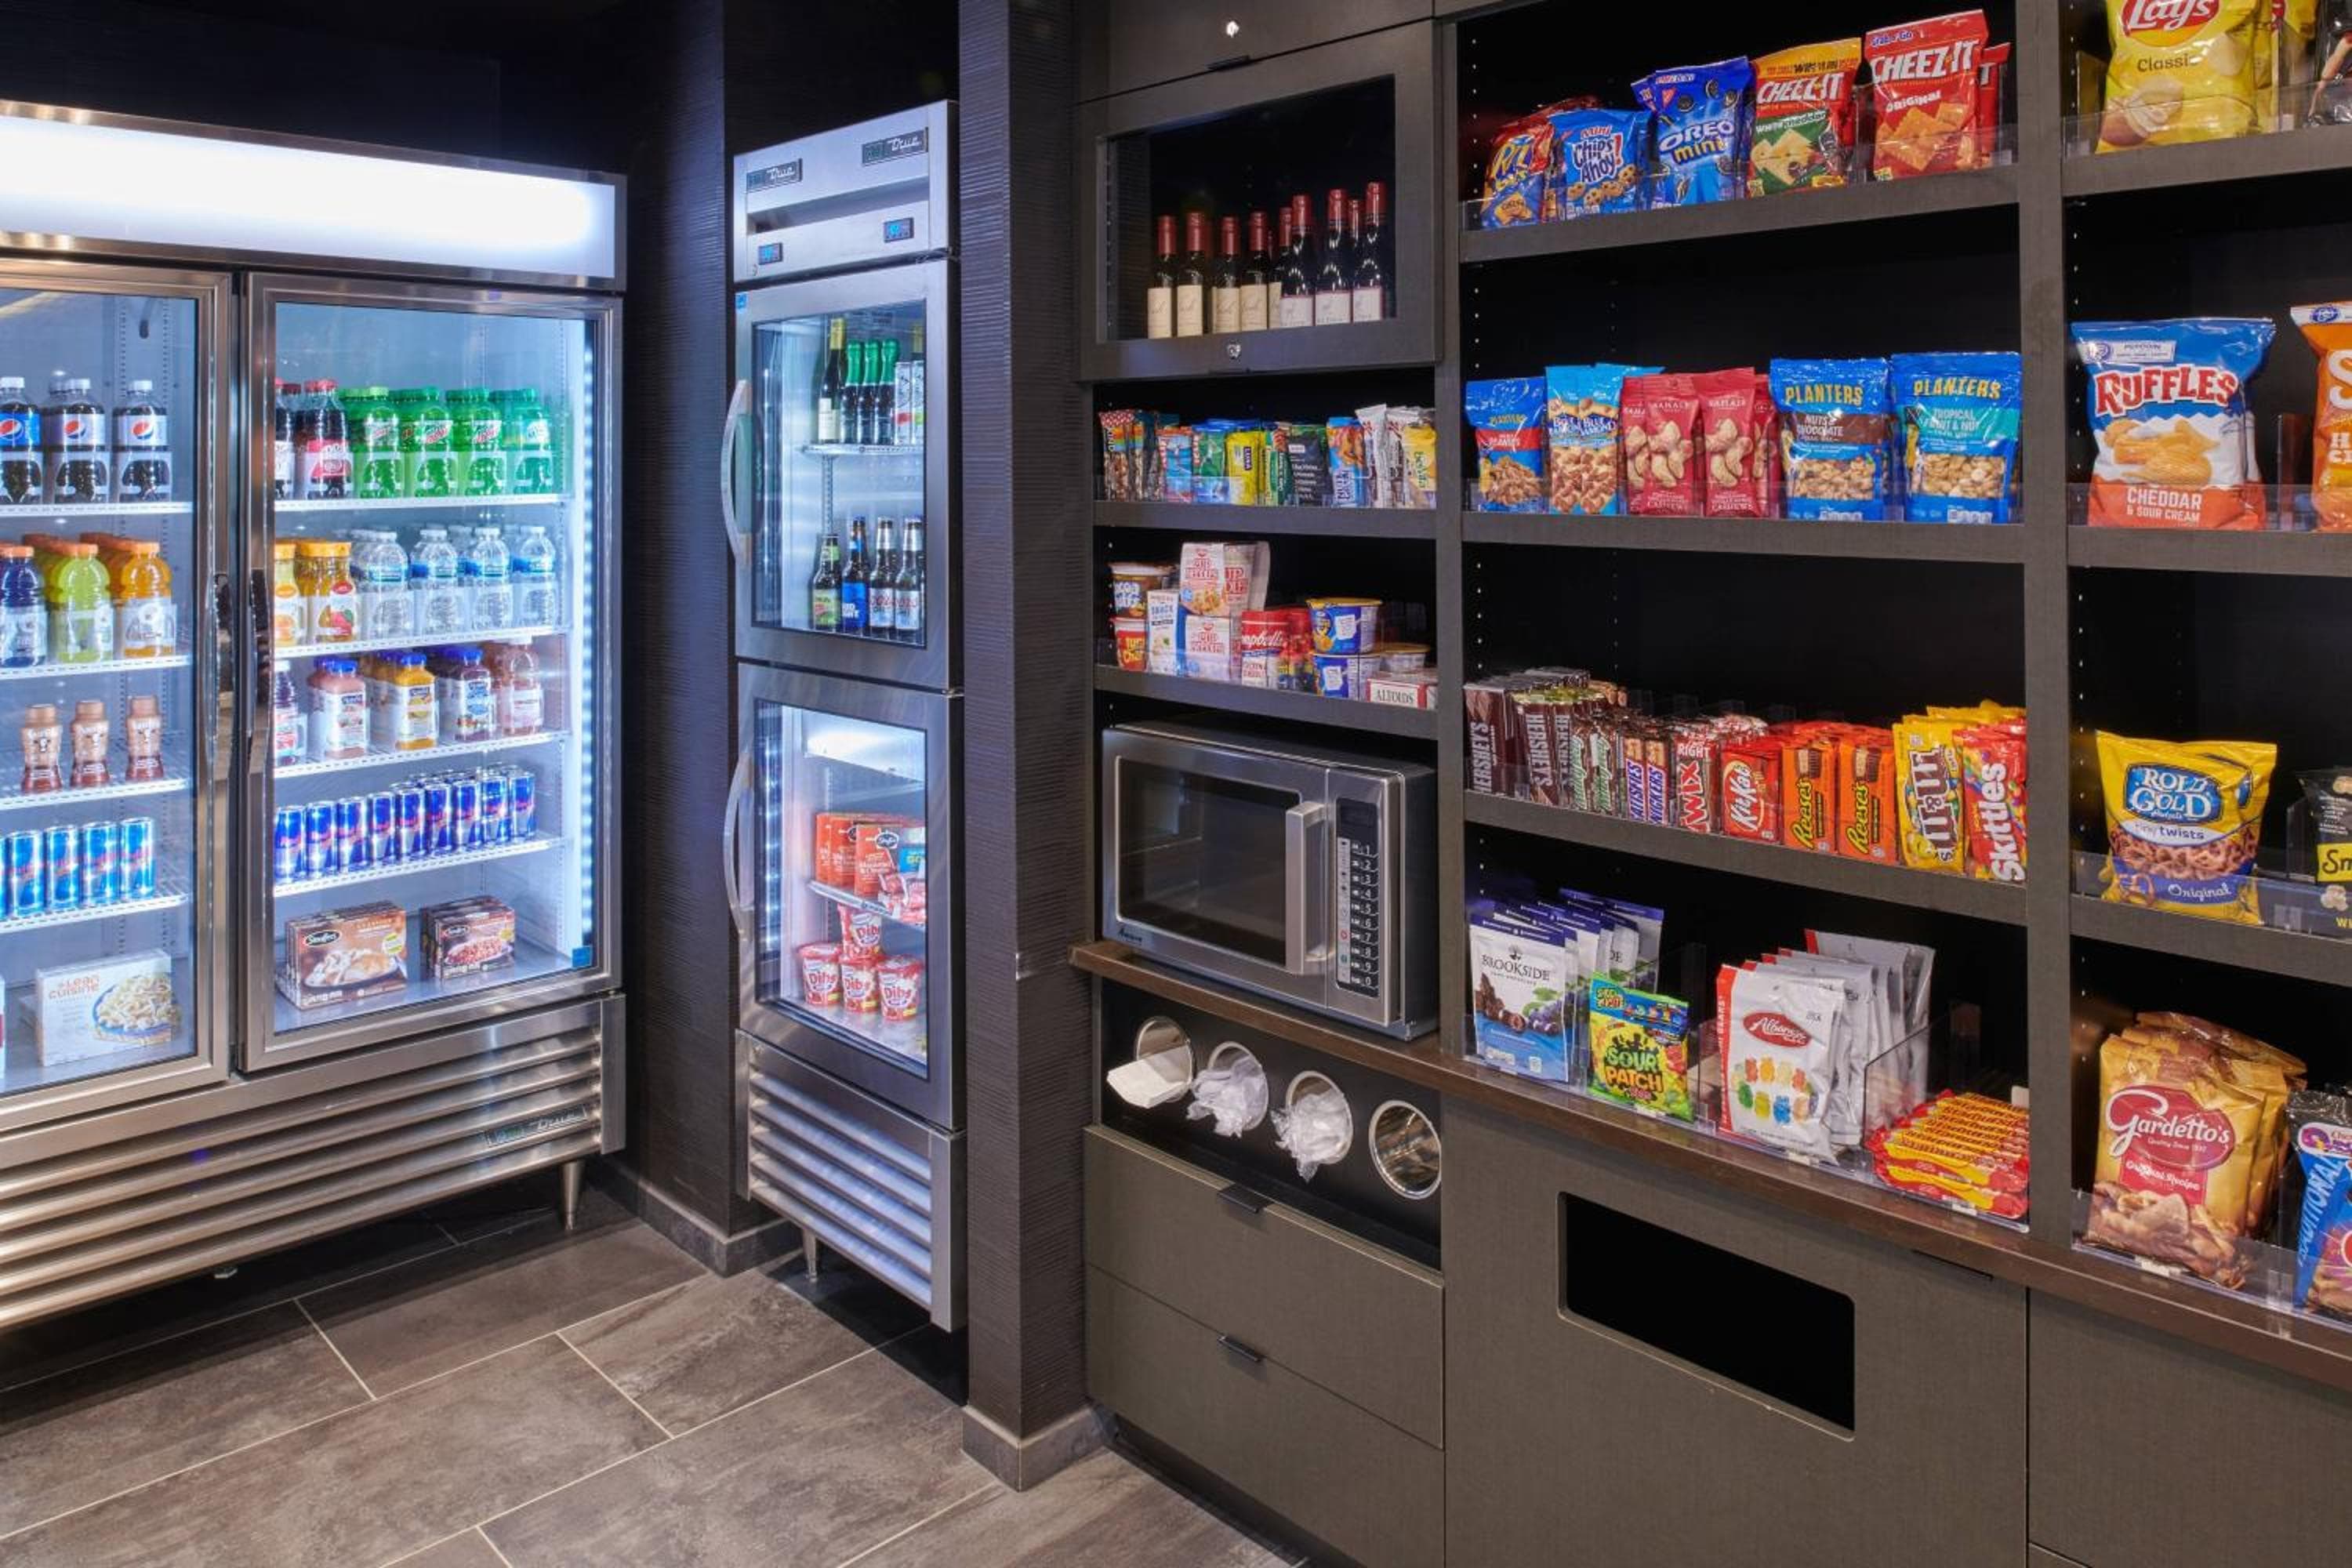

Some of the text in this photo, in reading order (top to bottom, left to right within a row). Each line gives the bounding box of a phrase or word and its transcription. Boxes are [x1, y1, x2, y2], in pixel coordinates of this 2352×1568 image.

[2137, 53, 2199, 72] Classi
[1659, 120, 1735, 153] OREO
[1785, 385, 1864, 406] PLANTERS
[1913, 376, 2002, 399] PLANTERS
[2094, 364, 2239, 417] RUFFLES
[2126, 487, 2203, 510] CHEDDAR
[2136, 506, 2162, 518] SOUR
[1677, 745, 1711, 758] RIGHT
[2142, 768, 2209, 793] ROLD
[2132, 786, 2212, 819] GOLD
[2159, 824, 2205, 840] twists
[2167, 882, 2231, 902] Original
[1606, 1047, 1659, 1073] SOUR
[1605, 1065, 1664, 1093] PATCH
[2104, 1088, 2231, 1157] Gardetto's
